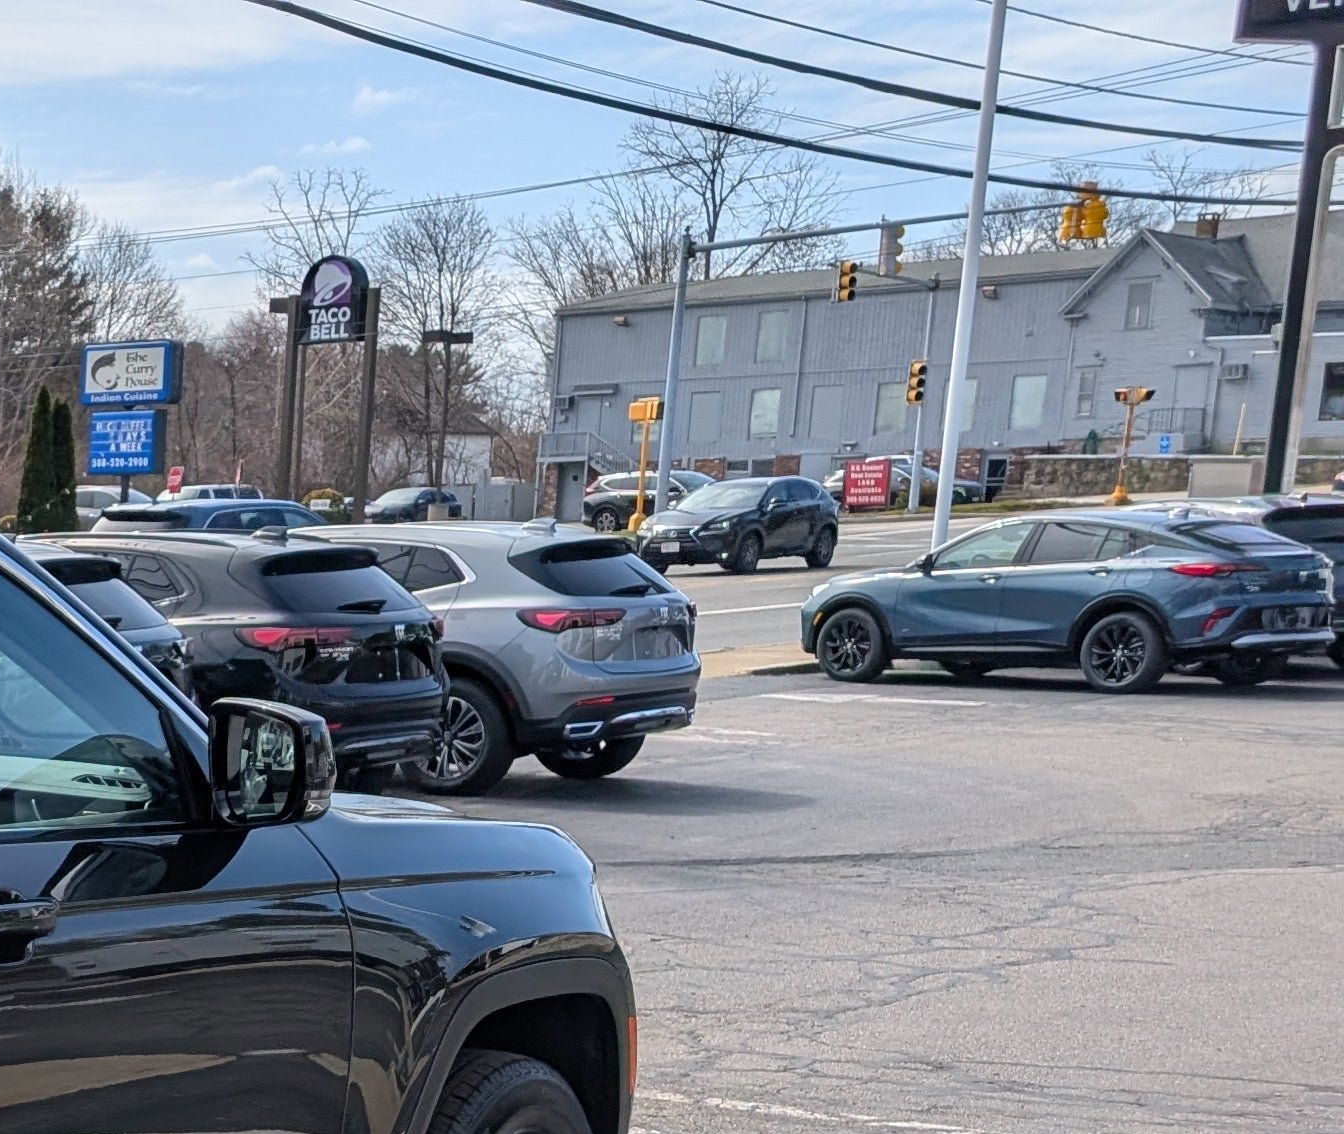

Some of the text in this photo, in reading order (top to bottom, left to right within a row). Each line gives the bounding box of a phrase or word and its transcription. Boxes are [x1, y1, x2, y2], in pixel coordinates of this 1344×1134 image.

[308, 306, 351, 324] TACO
[310, 323, 349, 340] BELL
[126, 351, 148, 363] The
[125, 363, 158, 377] Curry
[125, 376, 158, 388] House
[90, 391, 159, 403] Indian Cuisine
[119, 441, 143, 452] WEEK
